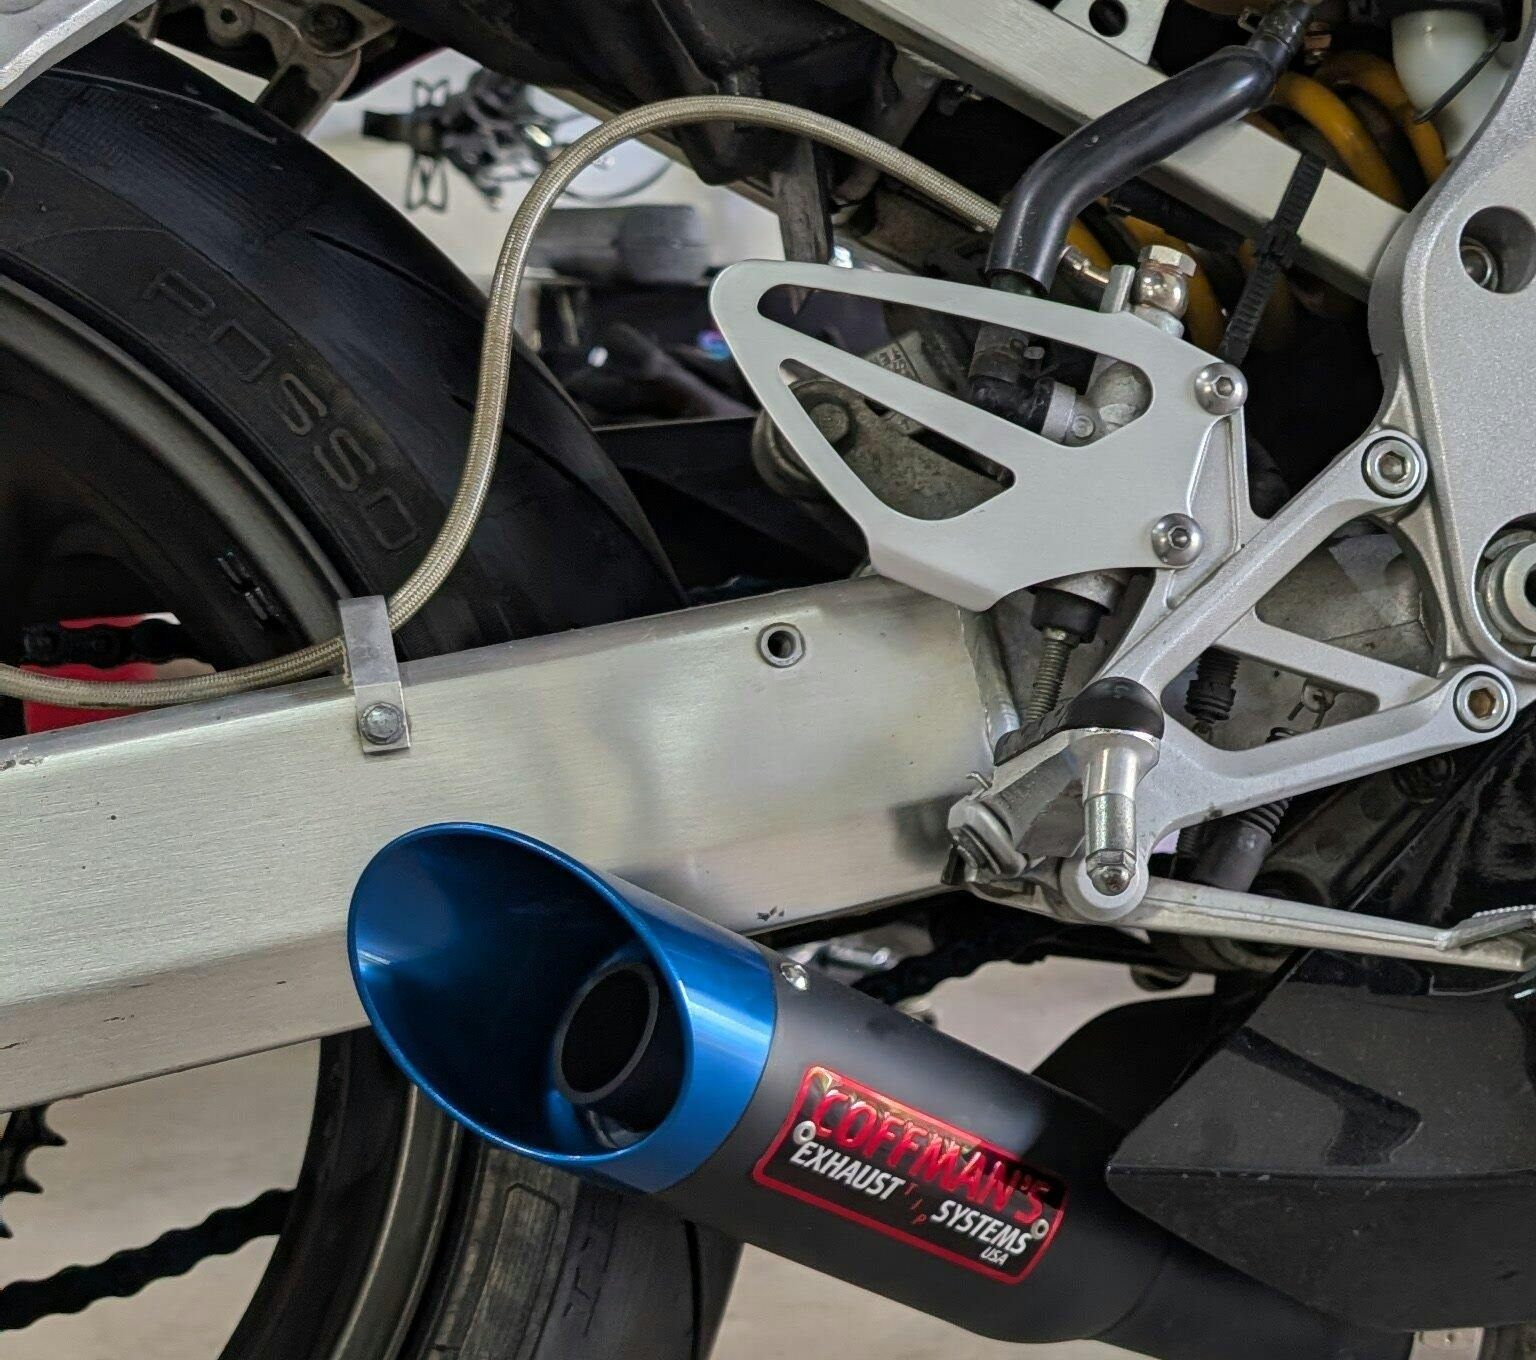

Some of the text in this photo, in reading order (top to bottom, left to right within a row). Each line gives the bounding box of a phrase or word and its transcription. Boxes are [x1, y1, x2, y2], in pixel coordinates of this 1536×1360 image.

[790, 1141, 907, 1201] EXHAUST
[930, 1198, 1033, 1256] SYSTEMS
[980, 1245, 1010, 1267] USA
